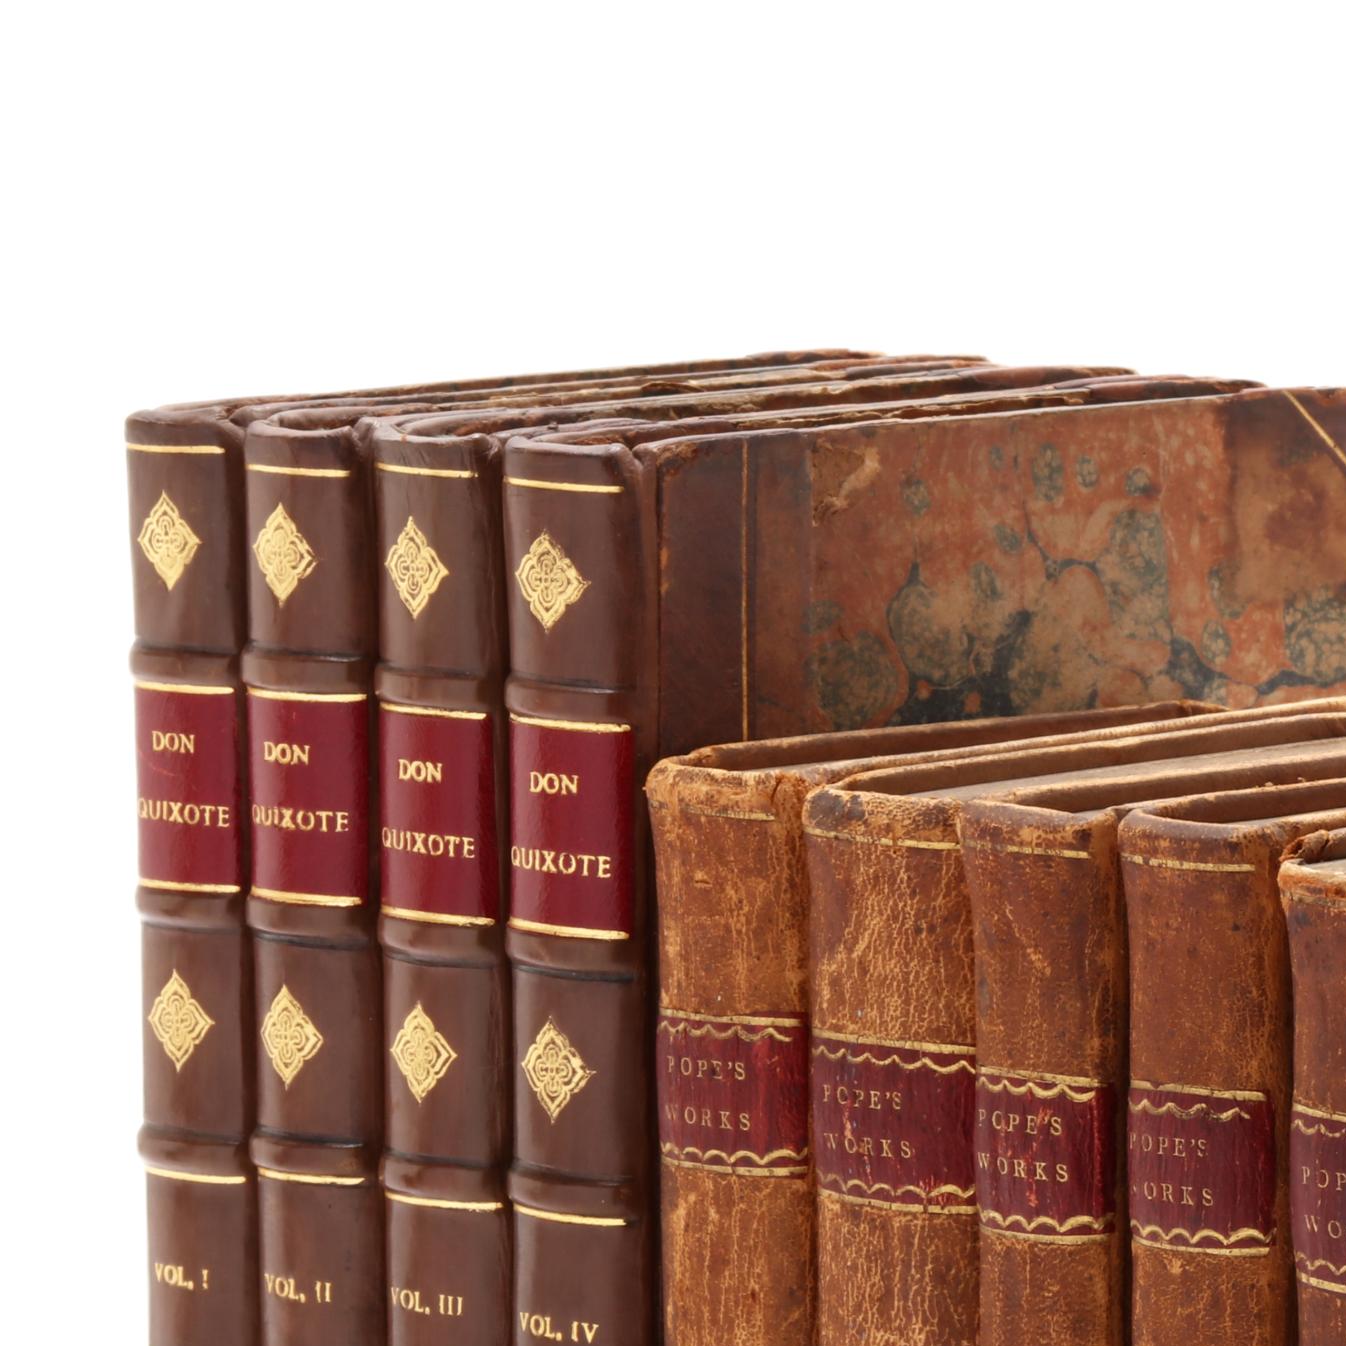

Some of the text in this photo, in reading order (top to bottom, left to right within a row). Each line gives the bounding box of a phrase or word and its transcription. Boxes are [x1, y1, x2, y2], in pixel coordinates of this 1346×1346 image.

[152, 731, 195, 754] DON
[264, 741, 309, 765] DON
[398, 759, 443, 783] DON
[530, 771, 578, 795] DON
[138, 798, 230, 827] QUIXOTE
[252, 804, 349, 832] QUIXOTE
[382, 827, 475, 858] QUIXOTE
[511, 847, 612, 878] QUIXOTE
[667, 1056, 746, 1080] POPE'S
[823, 1084, 901, 1109] POPE'S
[665, 1104, 750, 1131] WORKS
[978, 1109, 1062, 1135] POPE'S
[823, 1133, 912, 1158] WORKS
[1129, 1132, 1208, 1157] POPE'S
[978, 1151, 1068, 1182] WORKS
[1132, 1181, 1214, 1206] ORKS
[154, 1263, 208, 1290] VOL. I
[264, 1273, 331, 1303] VOL. II
[391, 1287, 463, 1316] VOL. III
[520, 1312, 599, 1343] VOL. IV
